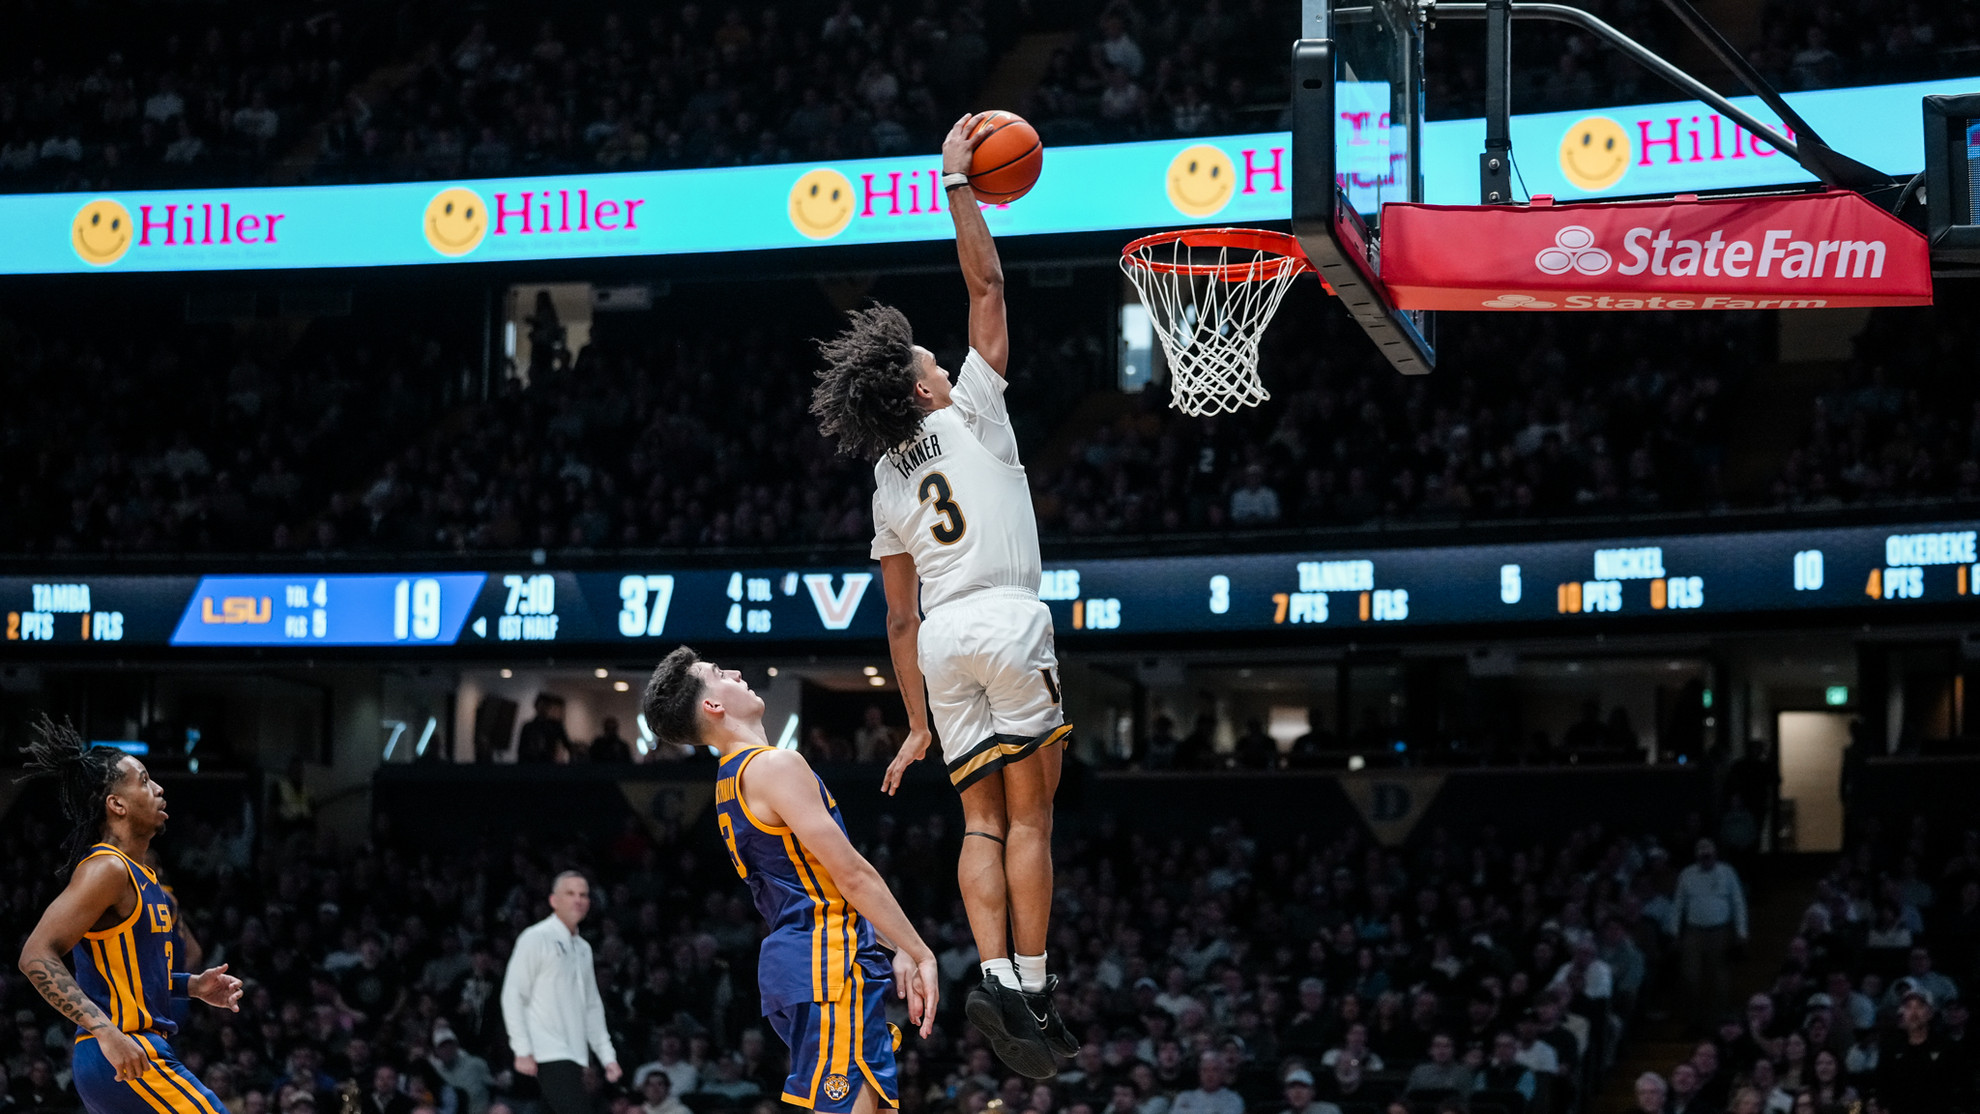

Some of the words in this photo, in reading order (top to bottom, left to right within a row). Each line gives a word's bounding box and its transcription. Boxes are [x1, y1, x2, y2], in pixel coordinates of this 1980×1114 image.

[493, 189, 645, 236] Hiller
[860, 170, 1010, 217] Hil
[138, 203, 286, 246] Hiller
[896, 434, 942, 480] TANNER
[918, 471, 967, 546] 3
[1594, 546, 1666, 580] NICKEL
[1886, 531, 1977, 567] OKEREKE
[726, 571, 743, 601] 4
[746, 578, 773, 602] TOL
[1297, 560, 1374, 593] TANNER
[1500, 564, 1522, 604] 5
[1794, 549, 1824, 591] 10
[1865, 568, 1882, 600] 4
[1883, 566, 1924, 599] PTS
[1957, 565, 1967, 595] 1
[32, 584, 91, 613] TAMBA
[202, 596, 272, 624] LSU
[312, 578, 328, 607] 4
[394, 578, 441, 640] 19
[503, 574, 555, 615] 7:10
[619, 574, 675, 637] 37
[802, 573, 873, 630] V
[1209, 574, 1230, 614] 3
[1272, 592, 1289, 624] 7
[1289, 592, 1329, 624] PTS
[1358, 590, 1370, 621] 1
[1372, 588, 1409, 621] FLS
[1557, 581, 1582, 614] 10
[1582, 580, 1622, 613] PTS
[1650, 578, 1666, 609] 0
[1667, 575, 1704, 609] FLS
[7, 611, 20, 640] 2
[21, 611, 55, 641] PTS
[81, 612, 90, 640] 1
[93, 611, 124, 640] FLS
[522, 614, 559, 641] HALF
[726, 603, 743, 633] 4
[746, 609, 772, 633] FLS
[1072, 600, 1083, 630] 1
[1085, 598, 1121, 629] FLS
[1372, 782, 1412, 821] D
